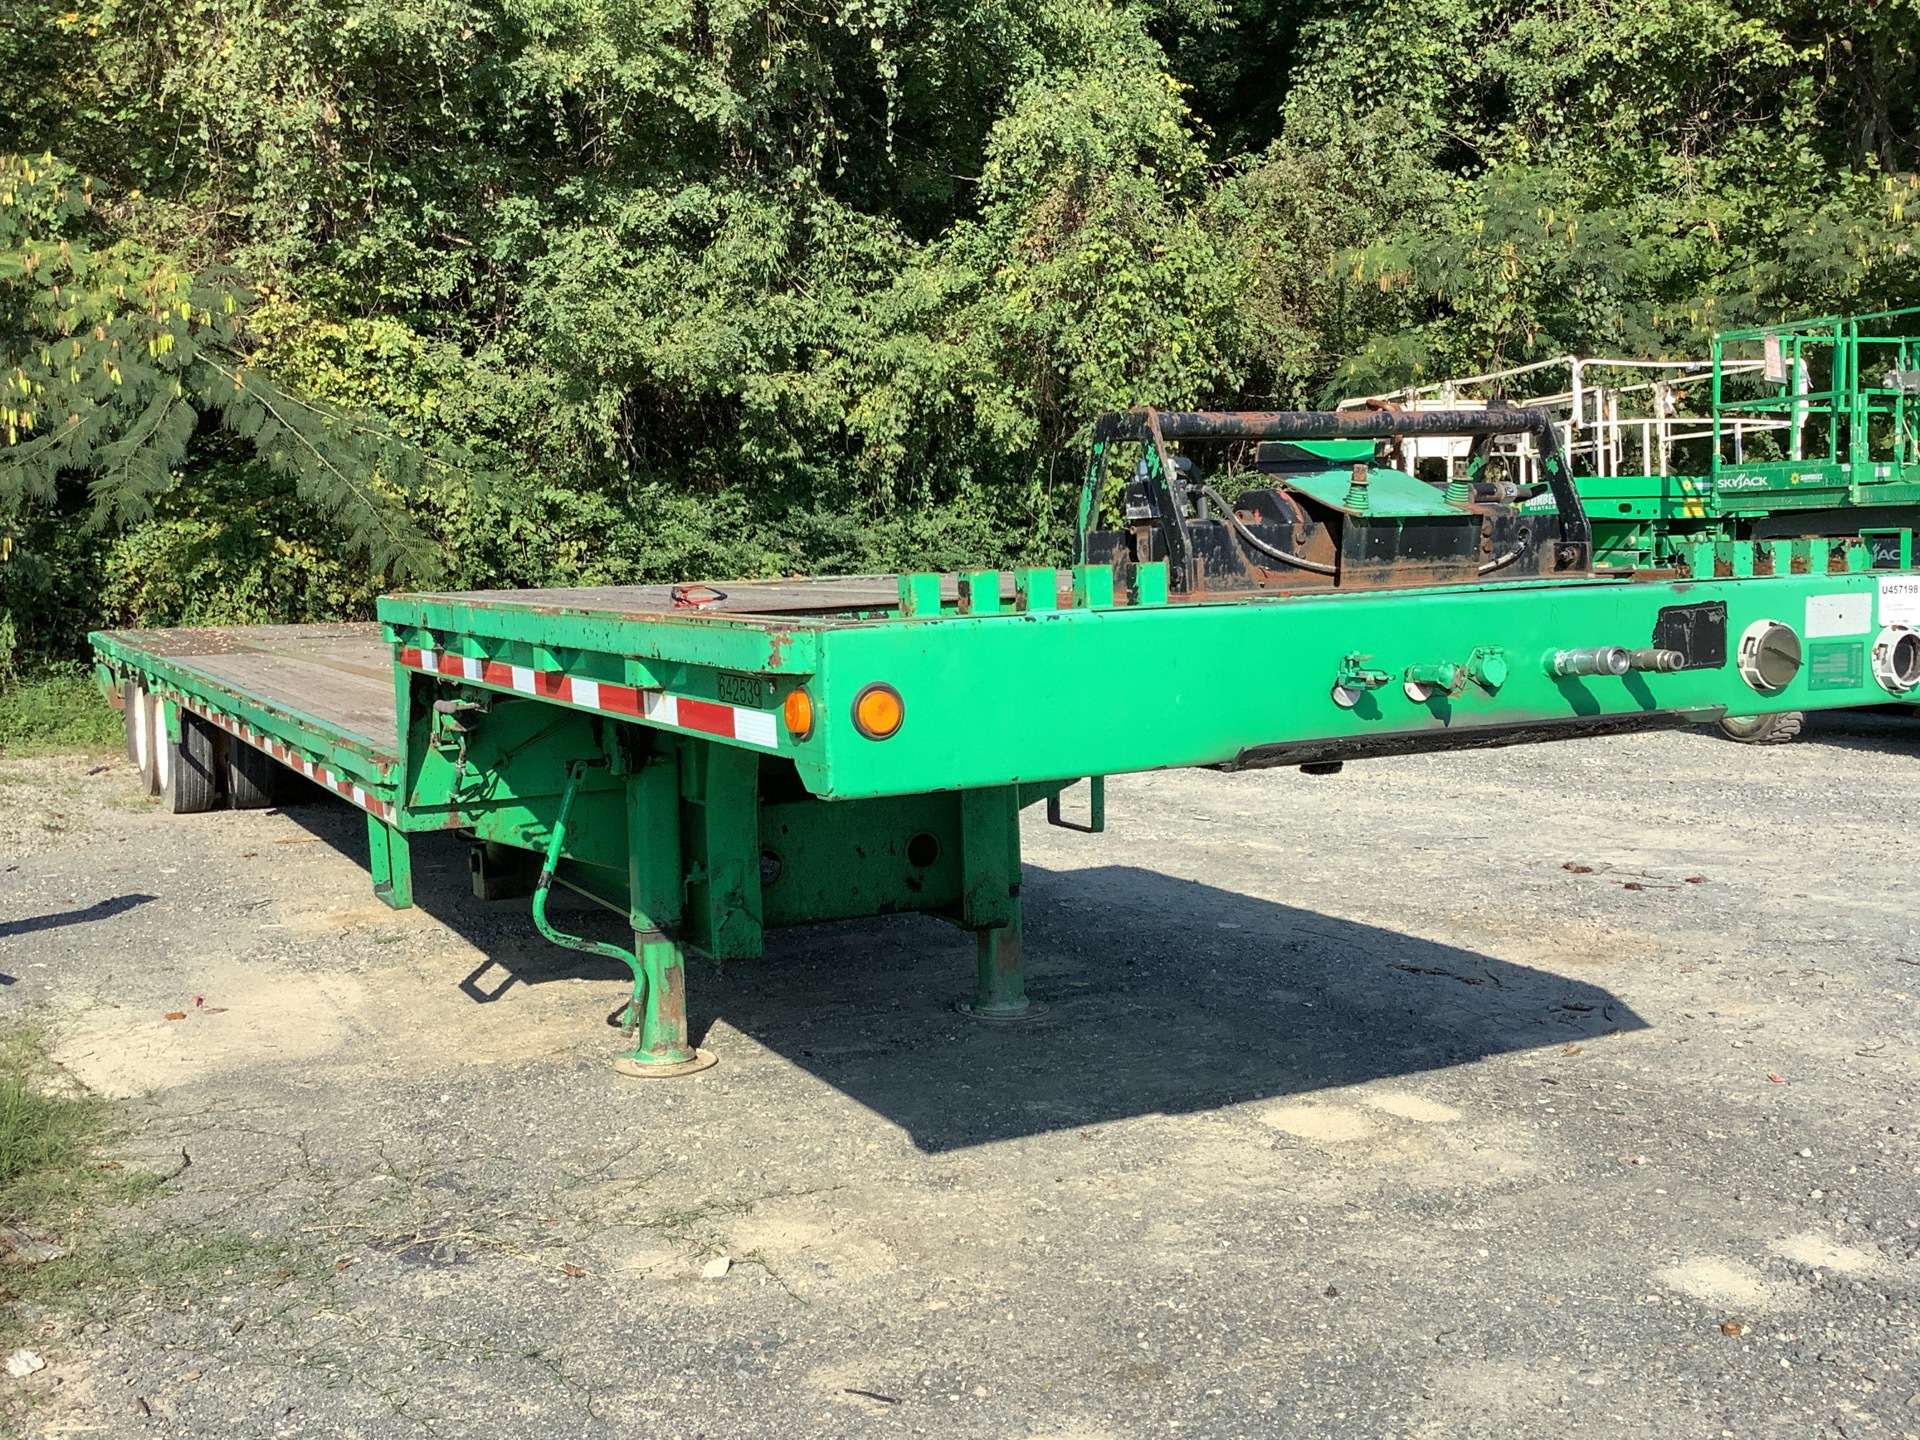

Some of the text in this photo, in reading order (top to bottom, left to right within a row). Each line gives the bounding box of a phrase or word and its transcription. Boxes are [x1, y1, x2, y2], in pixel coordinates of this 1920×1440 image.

[1717, 473, 1768, 489] SKYJACK
[1525, 493, 1557, 507] SUNBE
[1882, 584, 1919, 595] U457198
[719, 675, 761, 704] 642539
